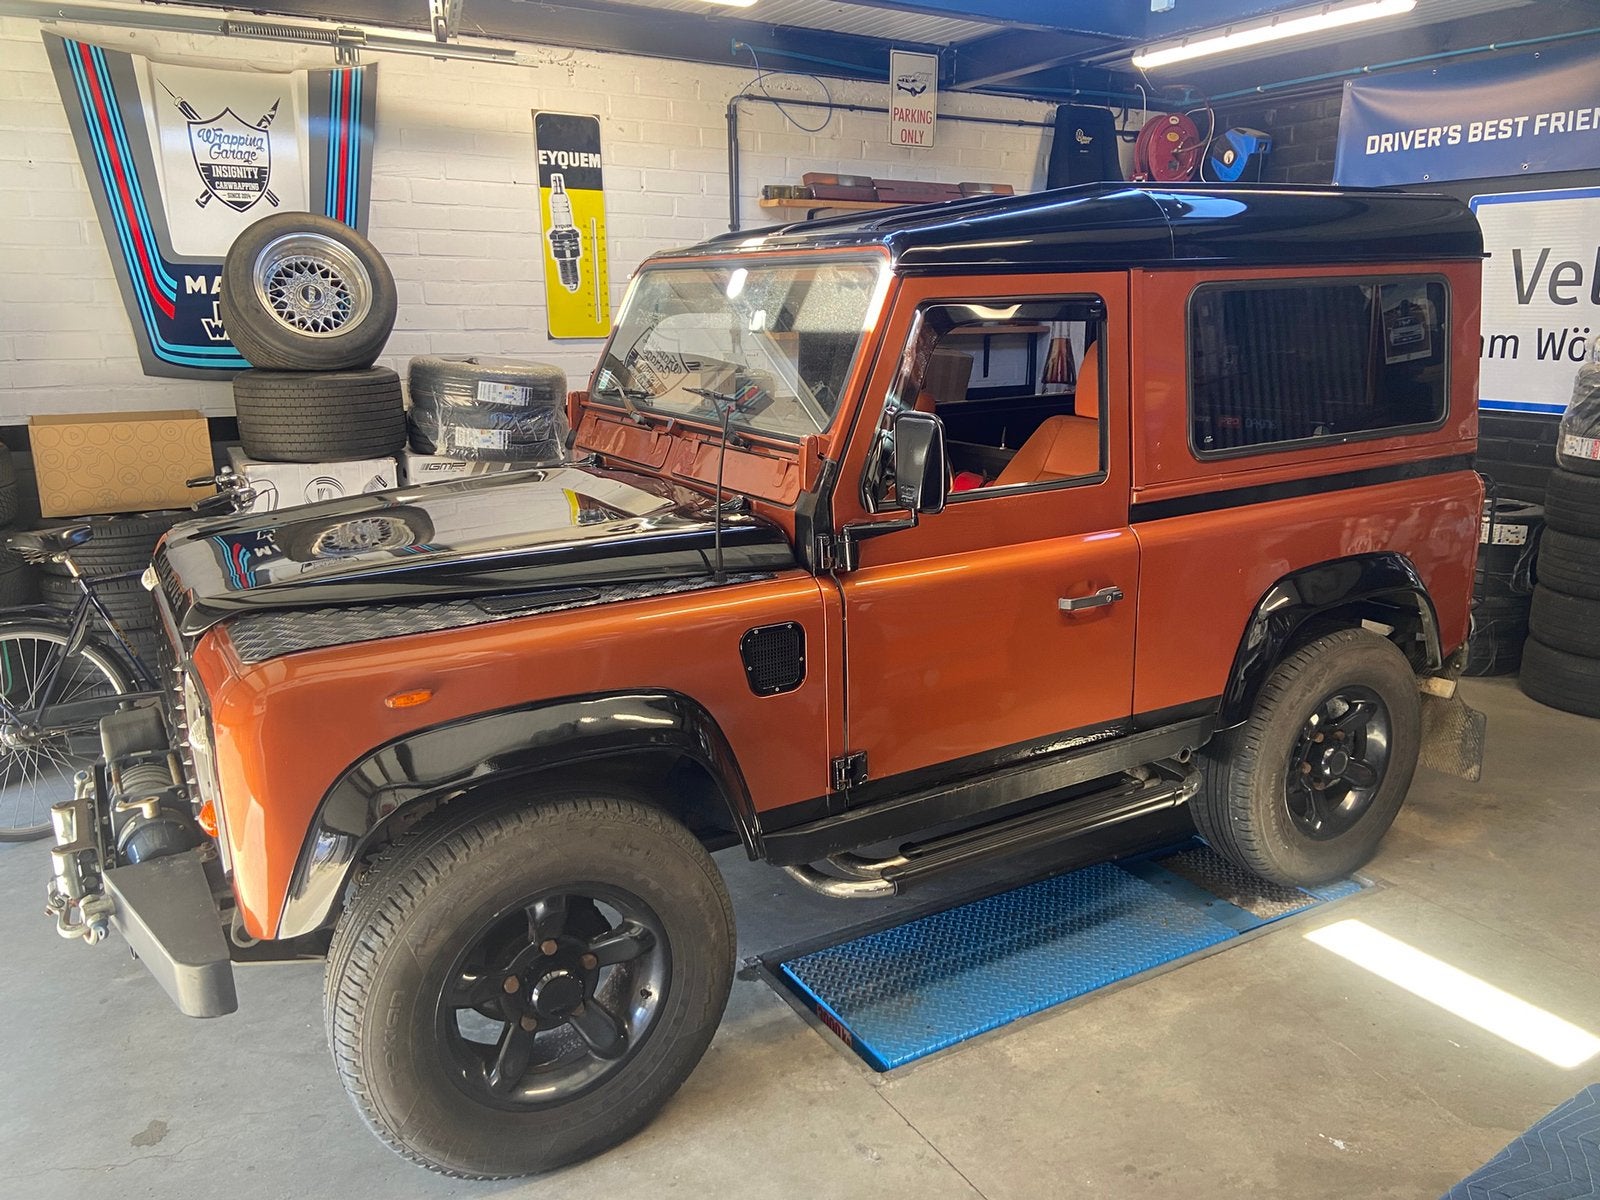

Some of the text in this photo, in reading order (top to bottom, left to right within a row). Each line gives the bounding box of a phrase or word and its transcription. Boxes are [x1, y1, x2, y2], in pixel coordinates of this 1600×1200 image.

[893, 107, 933, 125] PARKING
[197, 128, 265, 152] Wrapping
[900, 128, 925, 145] ONLY
[1365, 124, 1462, 155] DRIVER'S
[1467, 116, 1529, 143] BEST
[209, 143, 258, 164] Garage
[538, 149, 601, 169] EYQUEM
[211, 165, 259, 179] INSIGNITY
